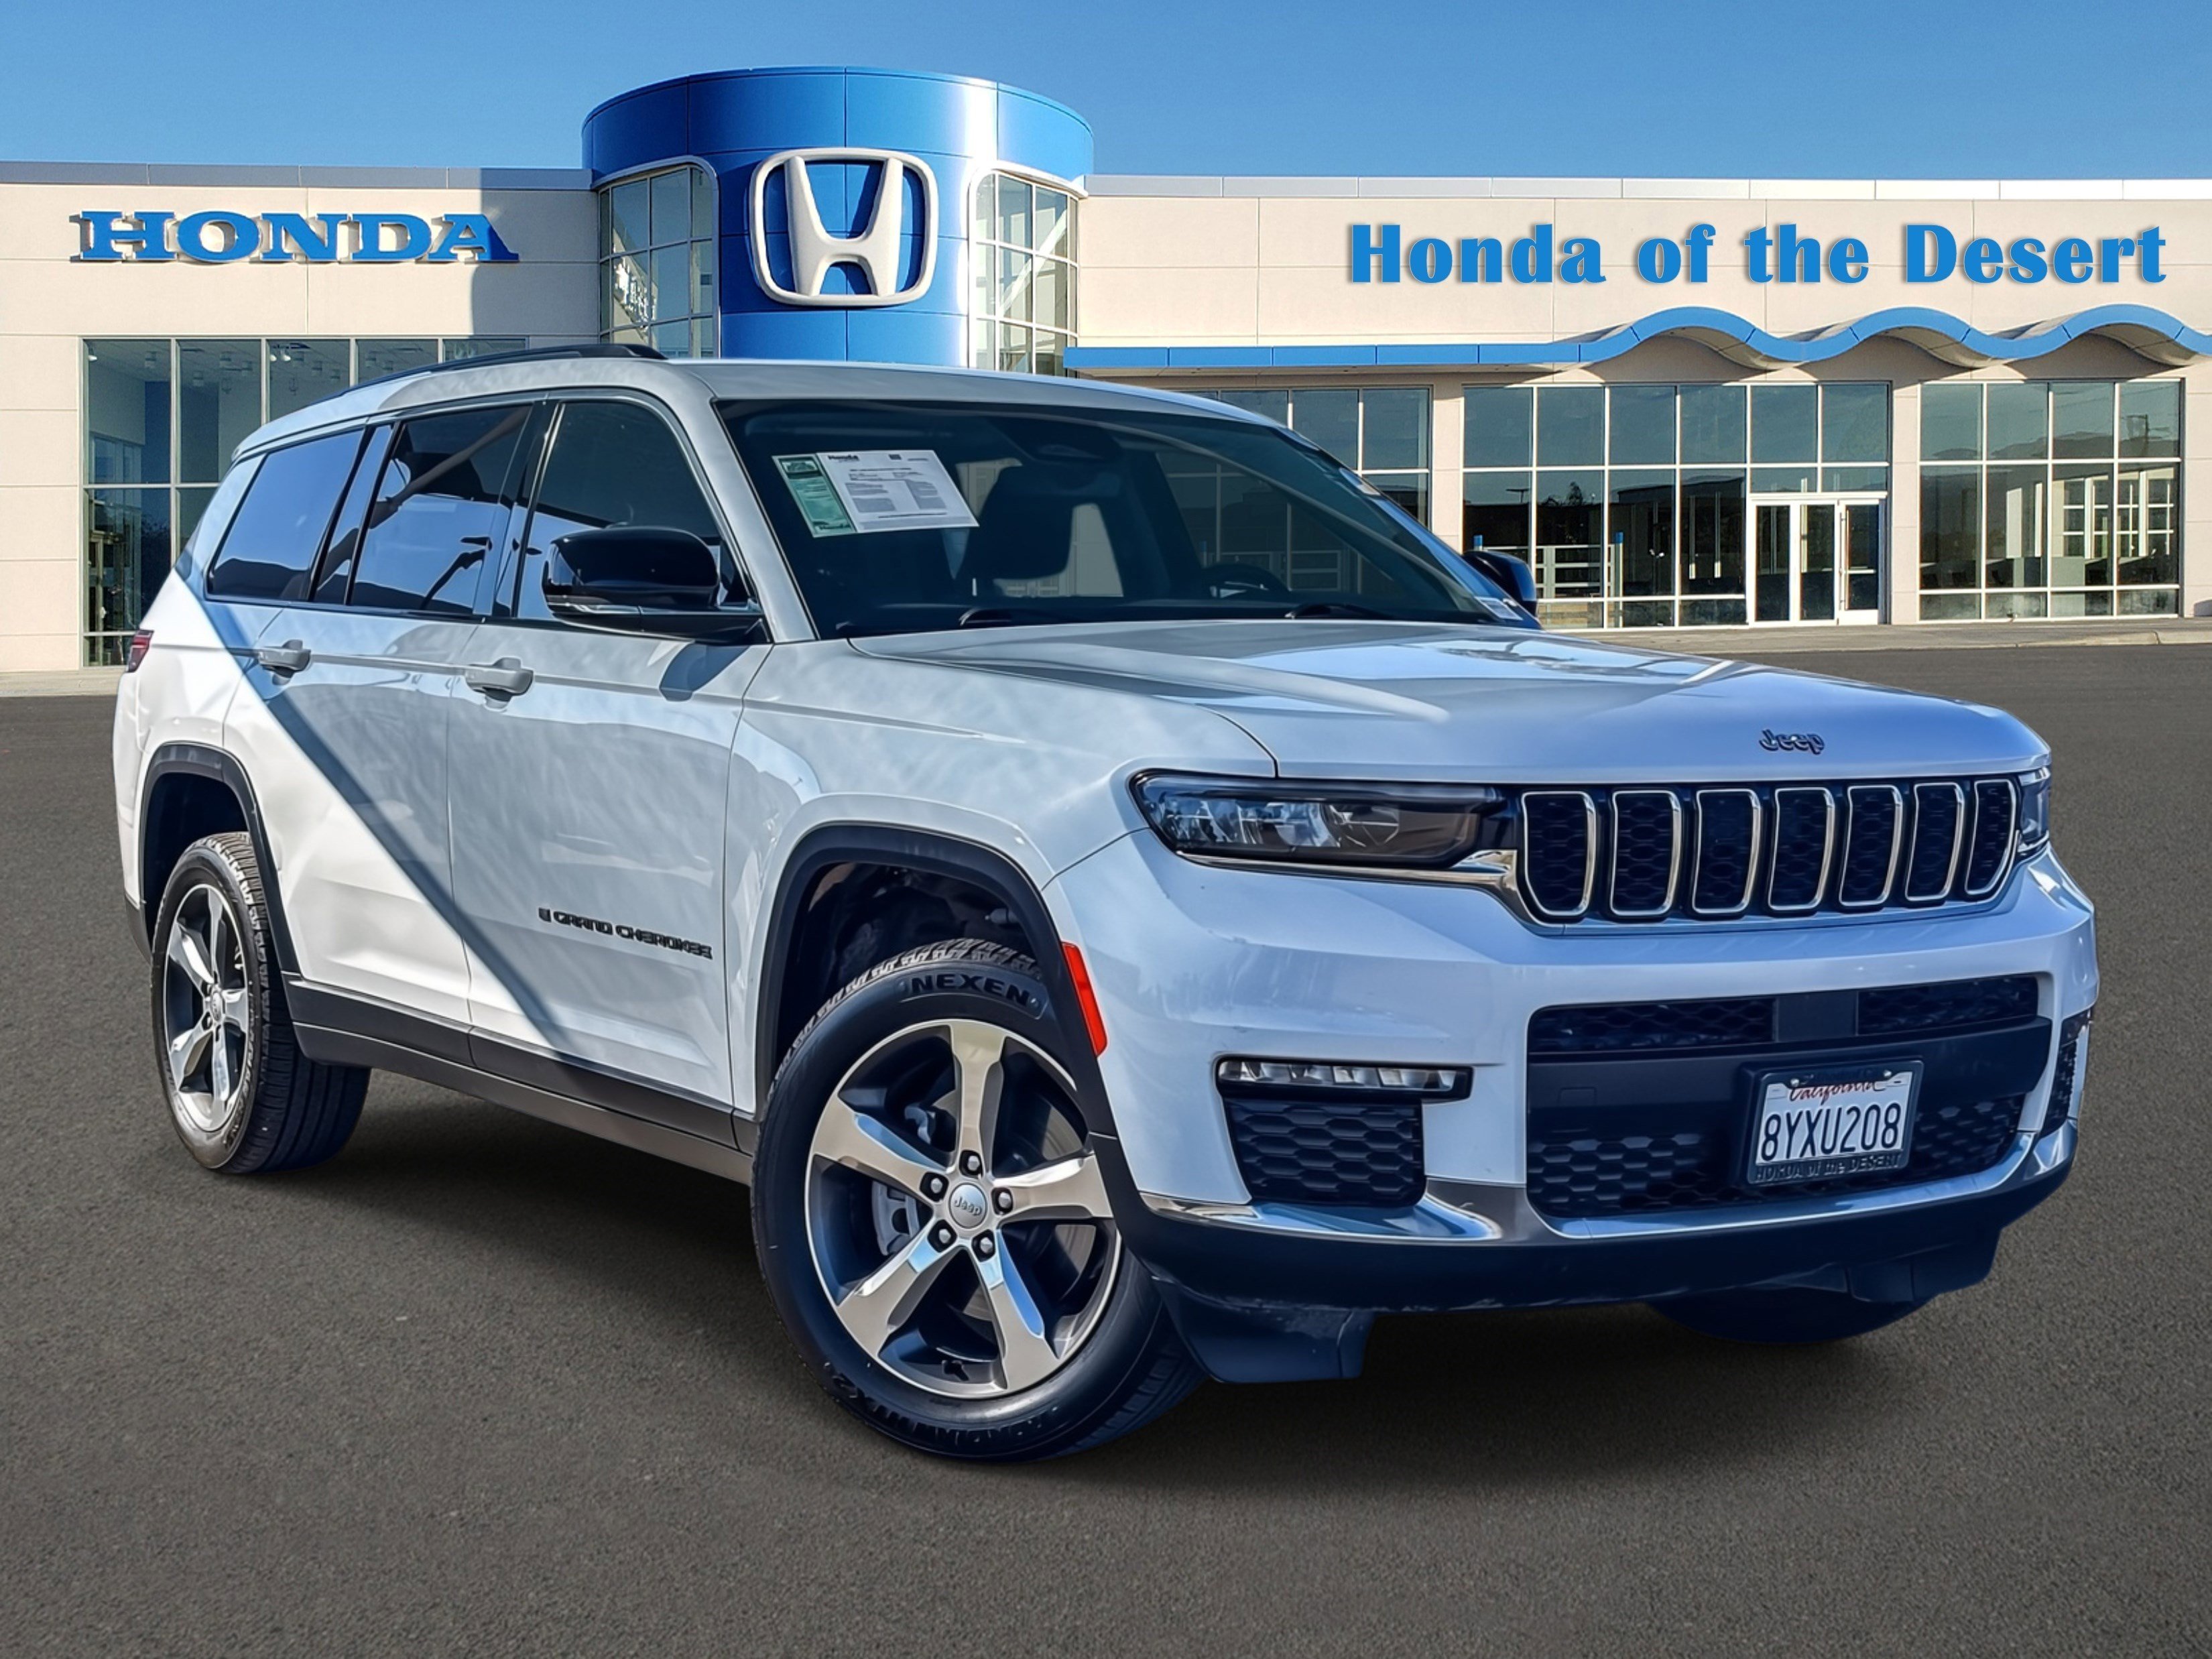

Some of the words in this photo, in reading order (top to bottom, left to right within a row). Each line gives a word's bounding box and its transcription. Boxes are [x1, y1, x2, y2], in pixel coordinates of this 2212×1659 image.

[80, 210, 519, 263] HONDA
[1351, 224, 1606, 284] Honda
[1638, 224, 1715, 284] of
[1743, 224, 1869, 284] the
[1906, 224, 2166, 284] Desert
[1759, 729, 1825, 755] Jeep
[554, 911, 613, 935] GRAND
[616, 924, 713, 959] CHEROKEE
[910, 973, 1029, 1007] NEXEN
[1761, 1103, 1901, 1162] 8YXU208
